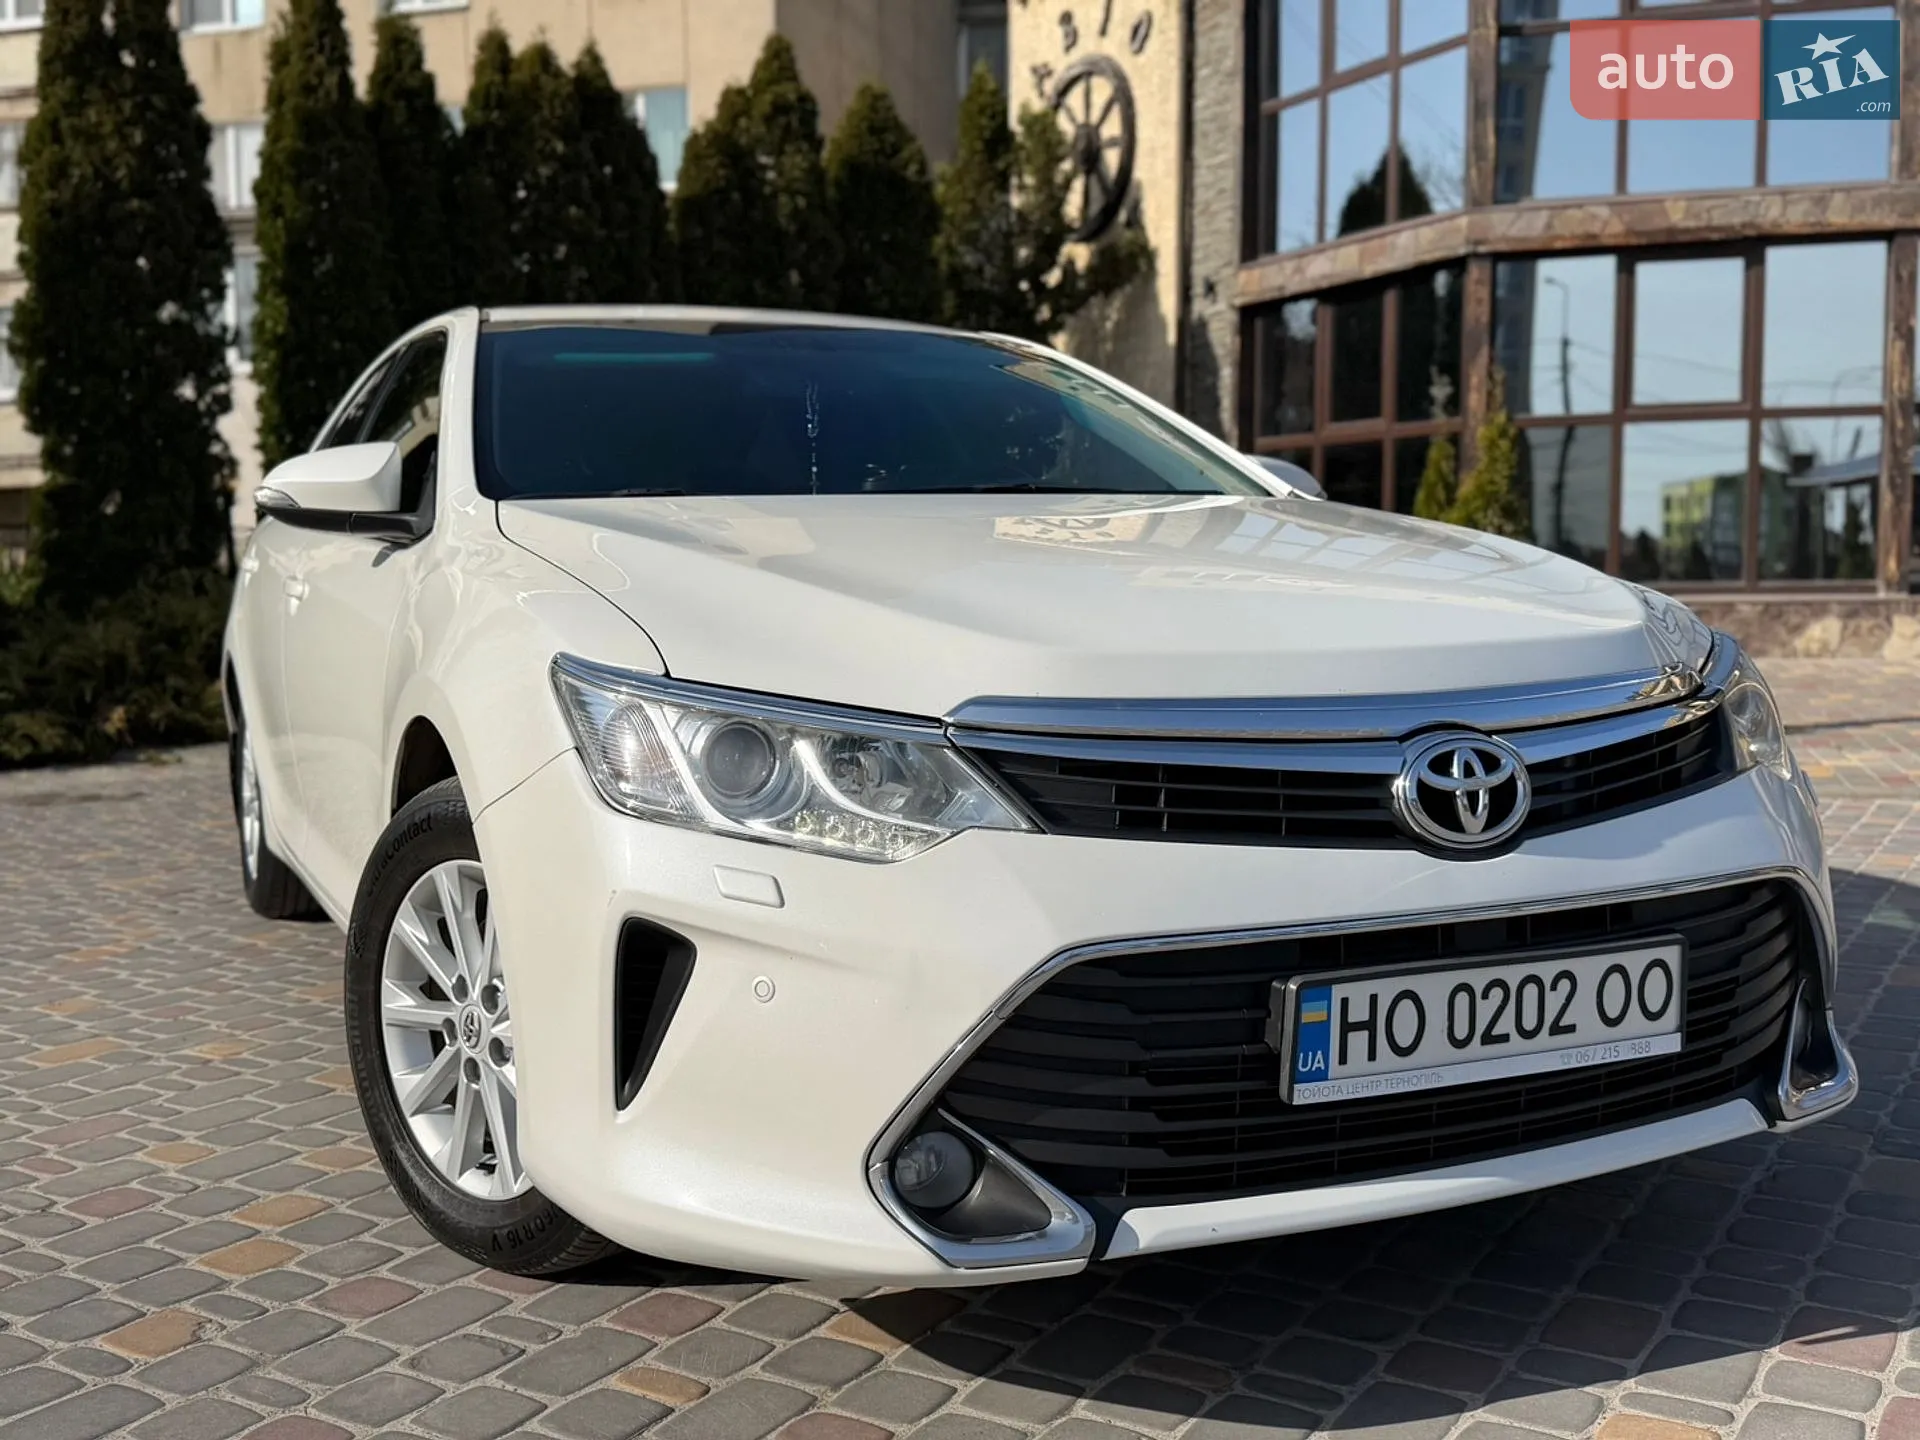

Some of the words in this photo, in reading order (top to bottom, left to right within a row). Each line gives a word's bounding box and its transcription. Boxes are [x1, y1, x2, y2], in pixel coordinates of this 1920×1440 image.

[1338, 989, 1426, 1066] HO
[1446, 969, 1578, 1050] 0202
[1596, 958, 1673, 1028] OO
[1297, 1050, 1326, 1072] UA
[1600, 1045, 1620, 1060] 215
[1346, 1078, 1382, 1096] ЦЕНТР
